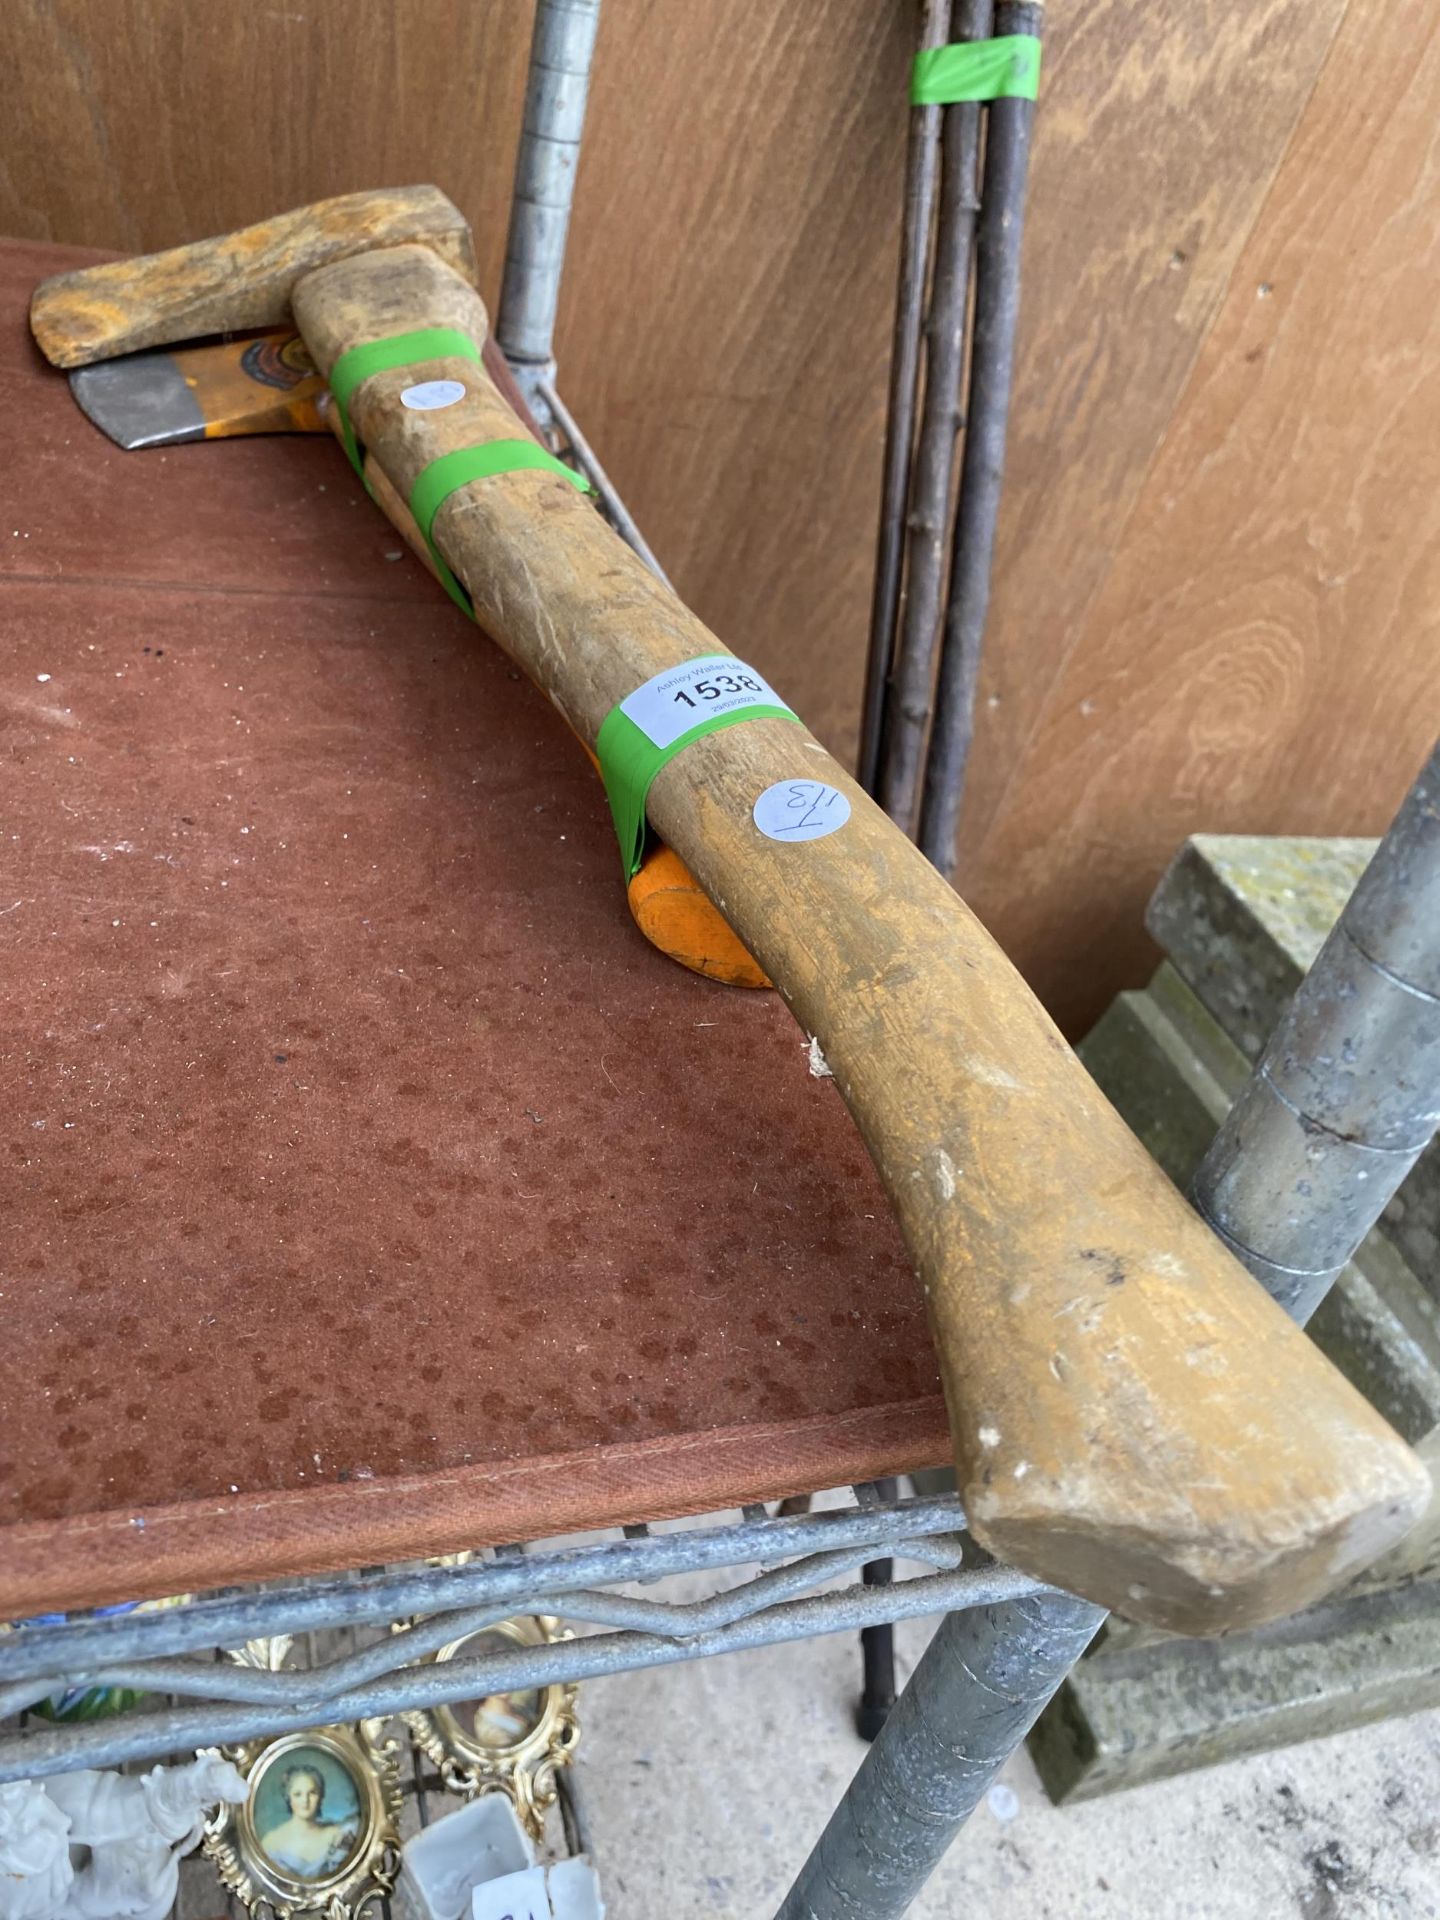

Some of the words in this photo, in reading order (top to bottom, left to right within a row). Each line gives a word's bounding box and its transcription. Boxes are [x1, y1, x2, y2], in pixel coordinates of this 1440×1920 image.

[657, 673, 691, 693] Ashley
[691, 664, 725, 676] Waller
[673, 675, 763, 708] 1538
